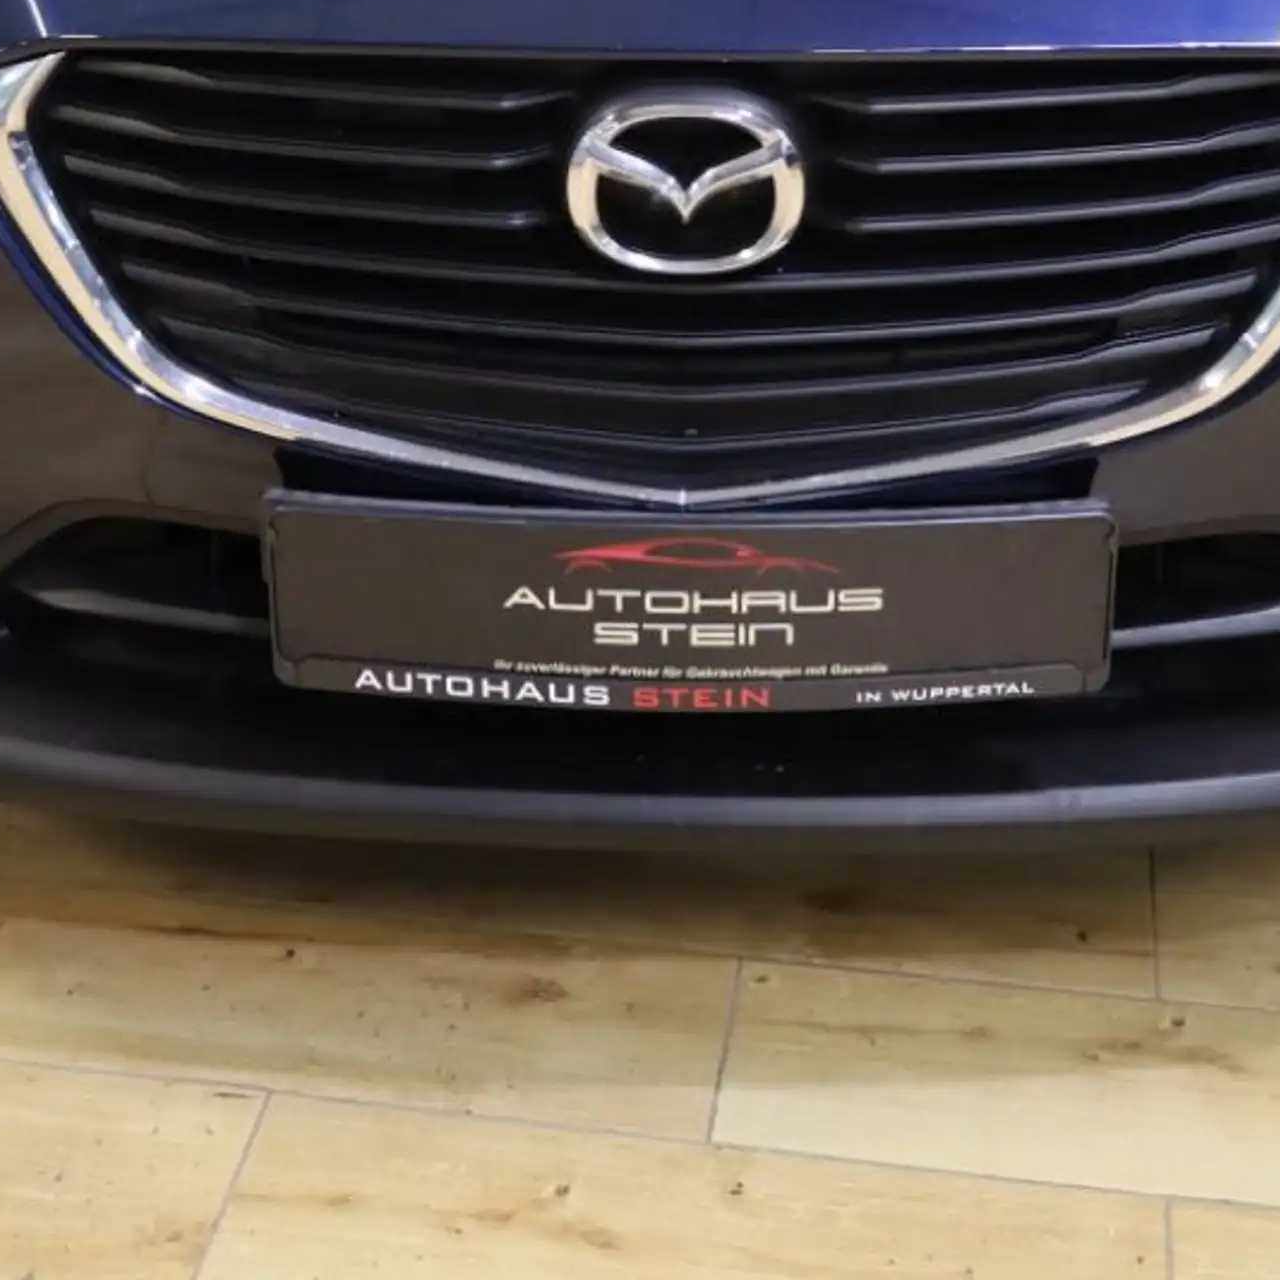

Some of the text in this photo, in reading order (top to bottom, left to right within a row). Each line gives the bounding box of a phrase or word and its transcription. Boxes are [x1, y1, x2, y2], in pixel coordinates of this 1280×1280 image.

[503, 585, 884, 615] AUTOHAUS
[593, 621, 795, 647] STEIN
[354, 668, 1036, 709] AUTOHAUS STEIN IN WUPPERTAL
